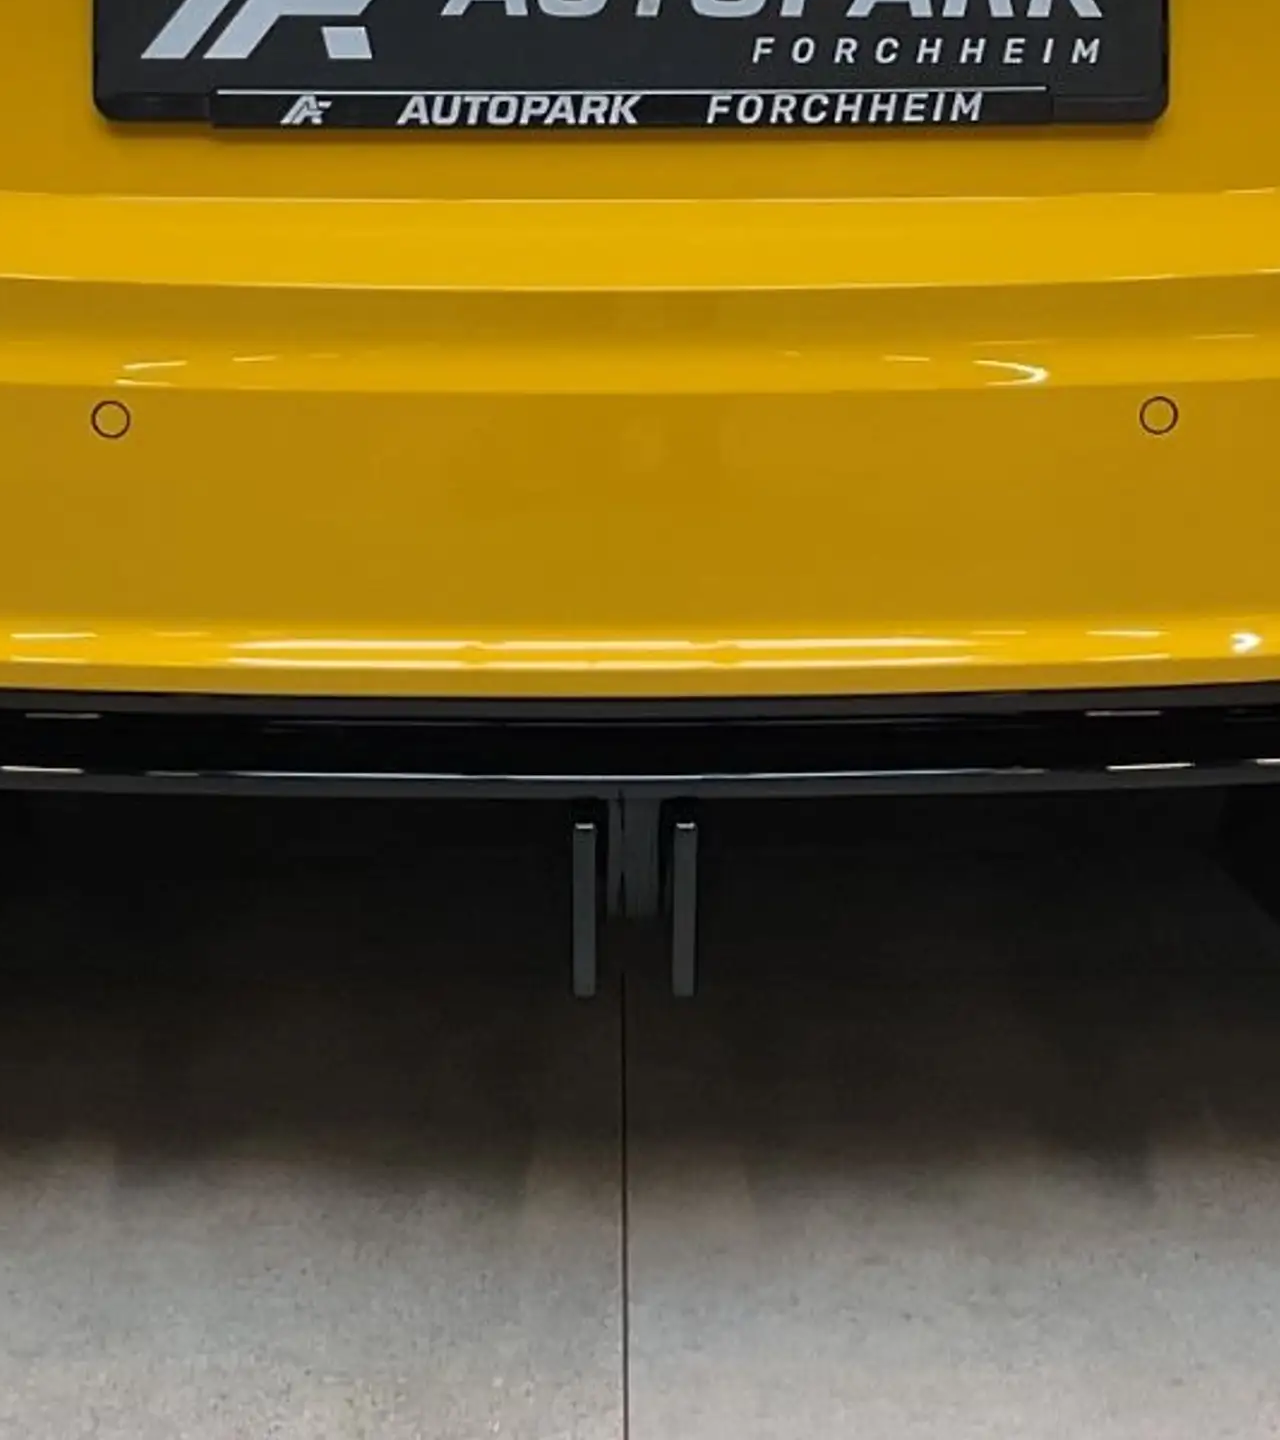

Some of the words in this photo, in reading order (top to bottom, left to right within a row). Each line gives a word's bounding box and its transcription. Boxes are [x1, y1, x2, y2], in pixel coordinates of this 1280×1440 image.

[752, 37, 1103, 64] FORCHHEIM
[396, 94, 642, 126] AUTOPARK
[707, 93, 984, 124] FORCHHEIM
